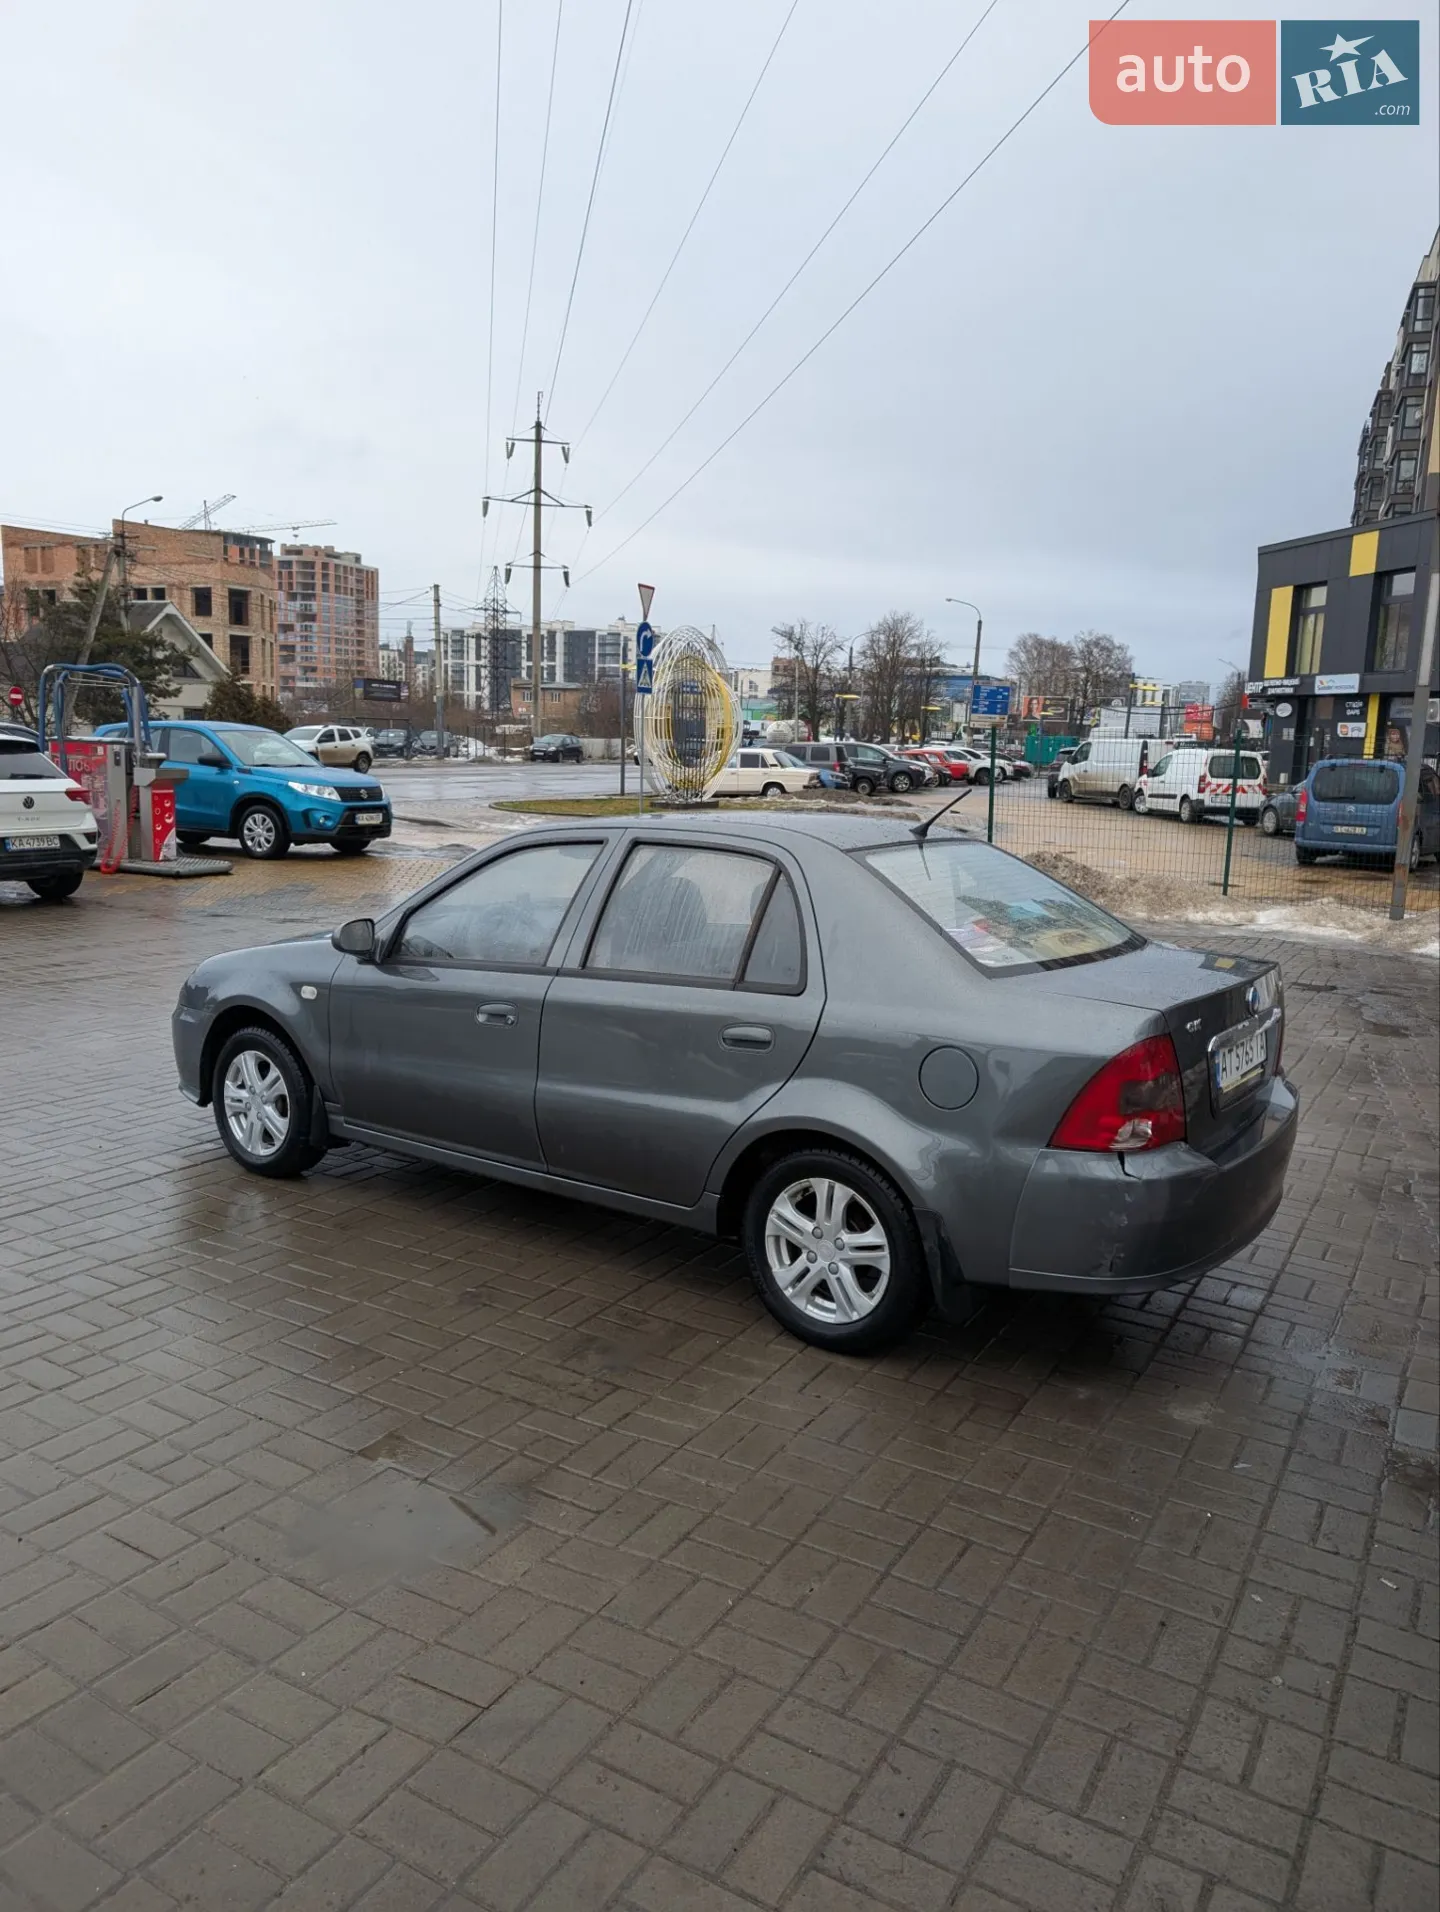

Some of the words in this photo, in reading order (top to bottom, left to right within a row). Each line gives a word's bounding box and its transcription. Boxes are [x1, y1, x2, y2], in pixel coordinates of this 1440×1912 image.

[11, 838, 25, 848] KA
[26, 837, 45, 848] 4739
[46, 836, 59, 847] BC
[1221, 1047, 1234, 1081] AT
